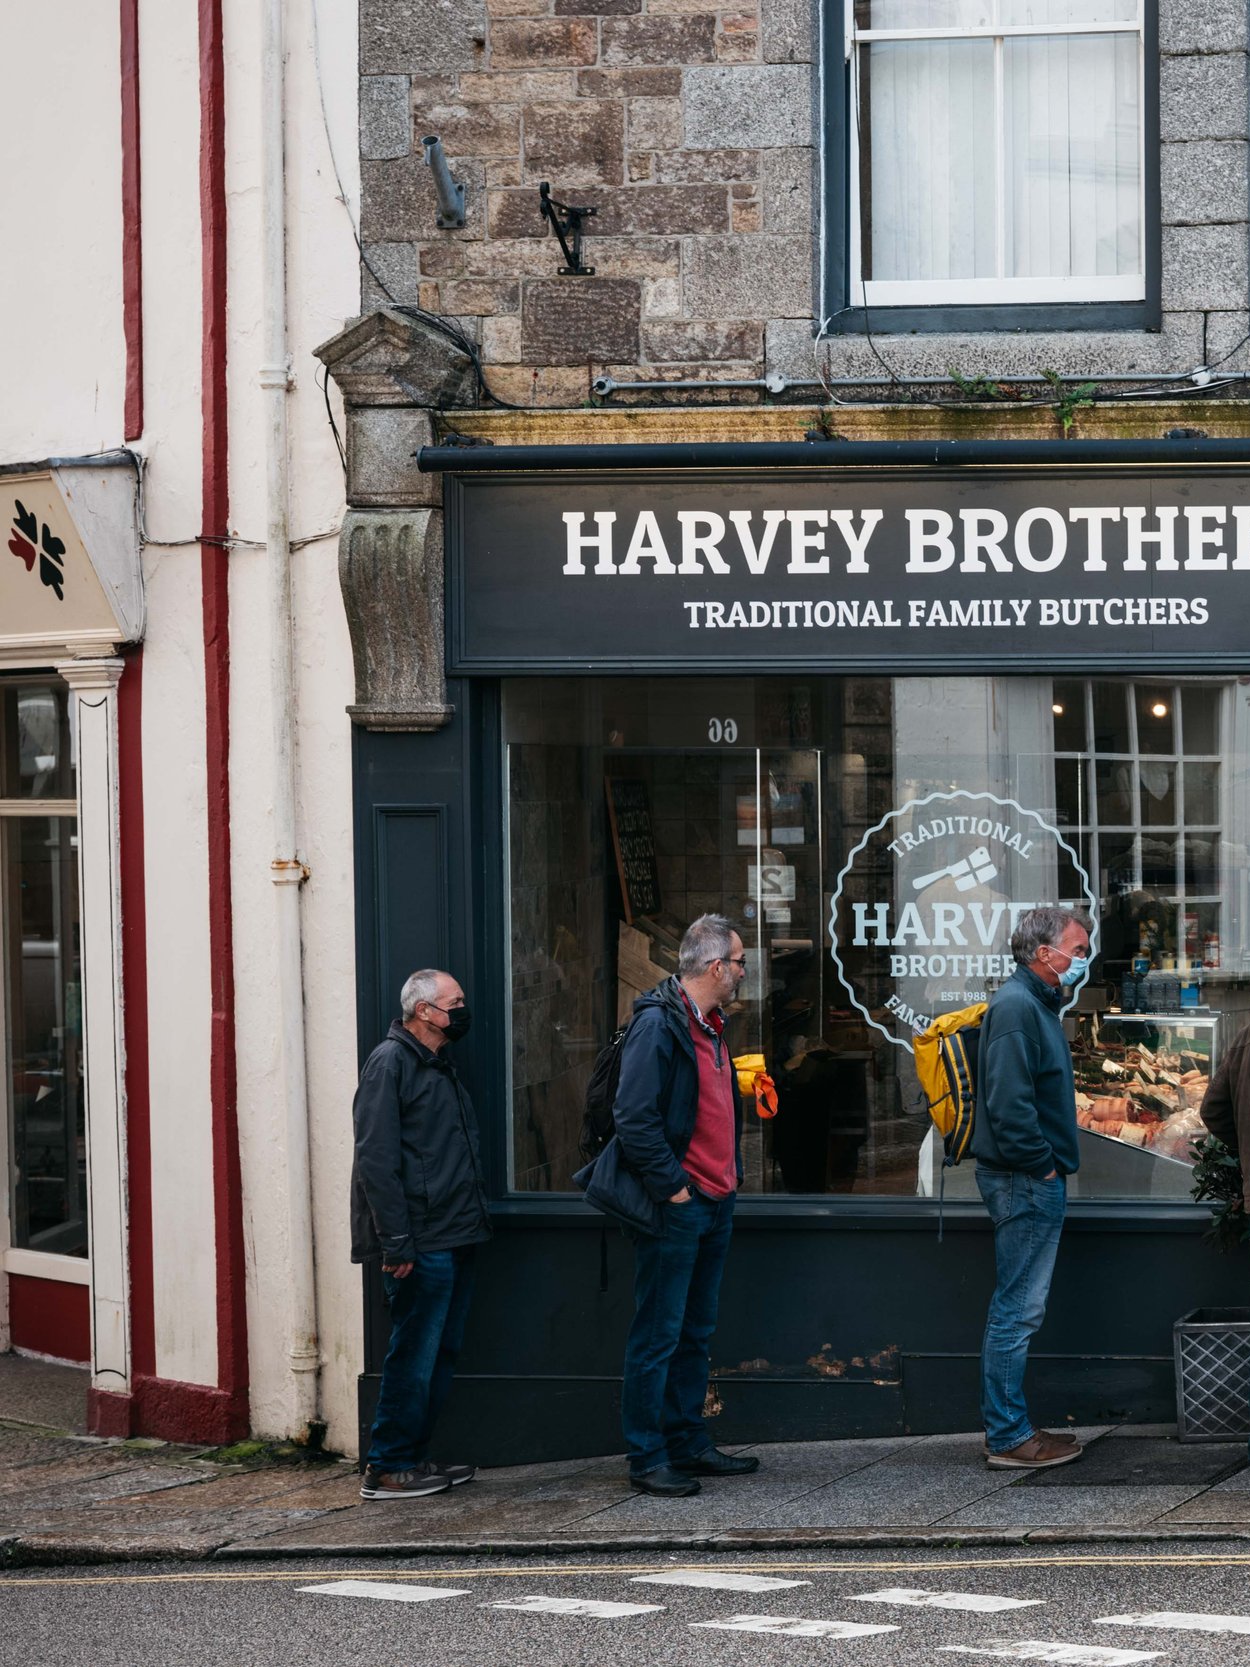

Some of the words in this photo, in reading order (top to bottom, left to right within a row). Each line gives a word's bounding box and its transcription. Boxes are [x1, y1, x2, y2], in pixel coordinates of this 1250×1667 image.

[562, 509, 884, 575] HARVEY
[684, 600, 902, 628] TRADITIONAL
[908, 599, 1031, 627] FAMILY
[1039, 598, 1209, 626] BUTCHERS
[887, 816, 1034, 860] TRADITIONAL
[852, 902, 1074, 947] HARV
[890, 954, 1018, 977] BROTHER
[941, 992, 960, 1002] EST
[963, 992, 987, 1002] 1988
